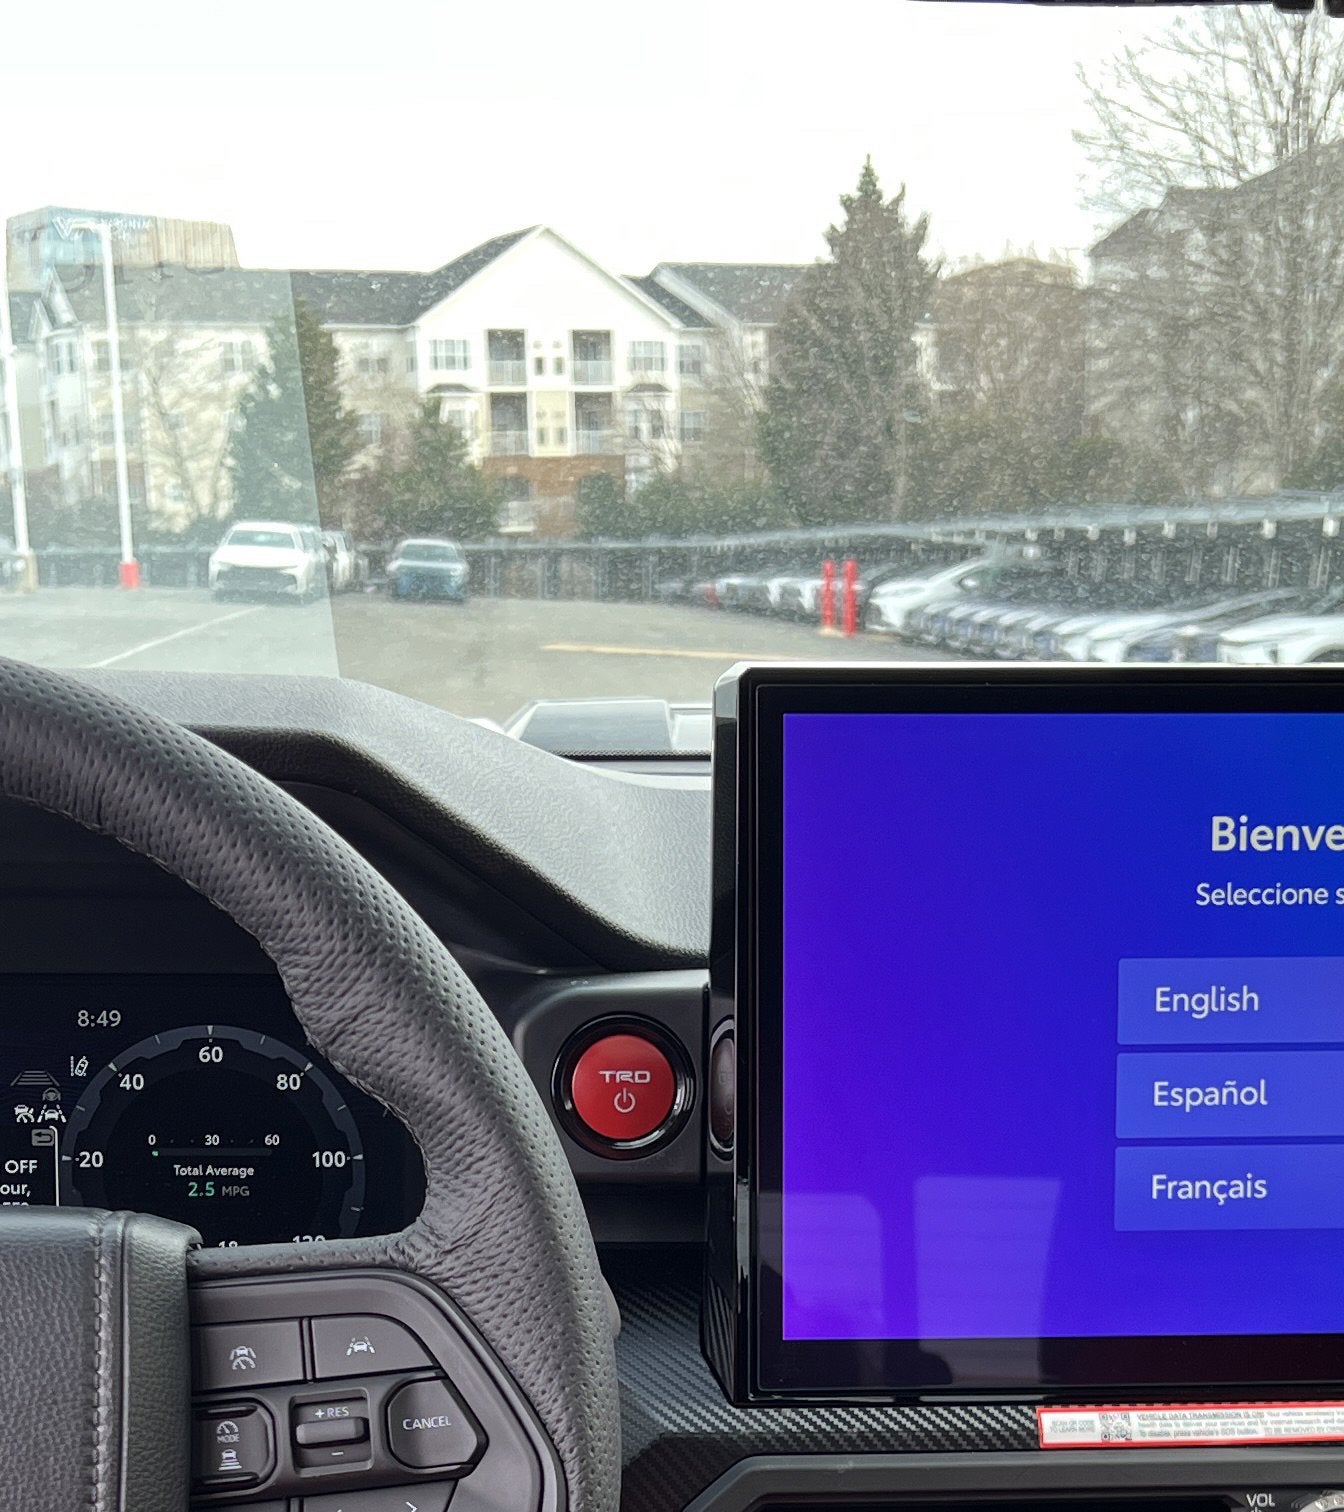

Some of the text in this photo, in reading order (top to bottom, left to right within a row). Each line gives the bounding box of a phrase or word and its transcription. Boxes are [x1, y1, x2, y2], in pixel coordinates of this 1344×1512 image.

[1195, 881, 1329, 908] Seleccione
[1153, 984, 1259, 1019] English
[77, 1010, 122, 1027] 8:49
[198, 1046, 223, 1063] 60
[120, 1074, 145, 1090] 40
[276, 1074, 301, 1090] 80
[598, 1070, 652, 1084] TRD
[1151, 1078, 1269, 1115] Español
[147, 1135, 280, 1146] 0 30 60
[4, 1160, 38, 1174] OFF
[79, 1151, 104, 1168] 20
[312, 1151, 346, 1168] 100
[173, 1164, 255, 1179] Total Average
[188, 1181, 250, 1198] 2.5 MPG
[1150, 1171, 1269, 1207] Français
[402, 1415, 453, 1431] CANCEL
[217, 1433, 241, 1444] MODE
[1246, 1493, 1276, 1507] VOL
